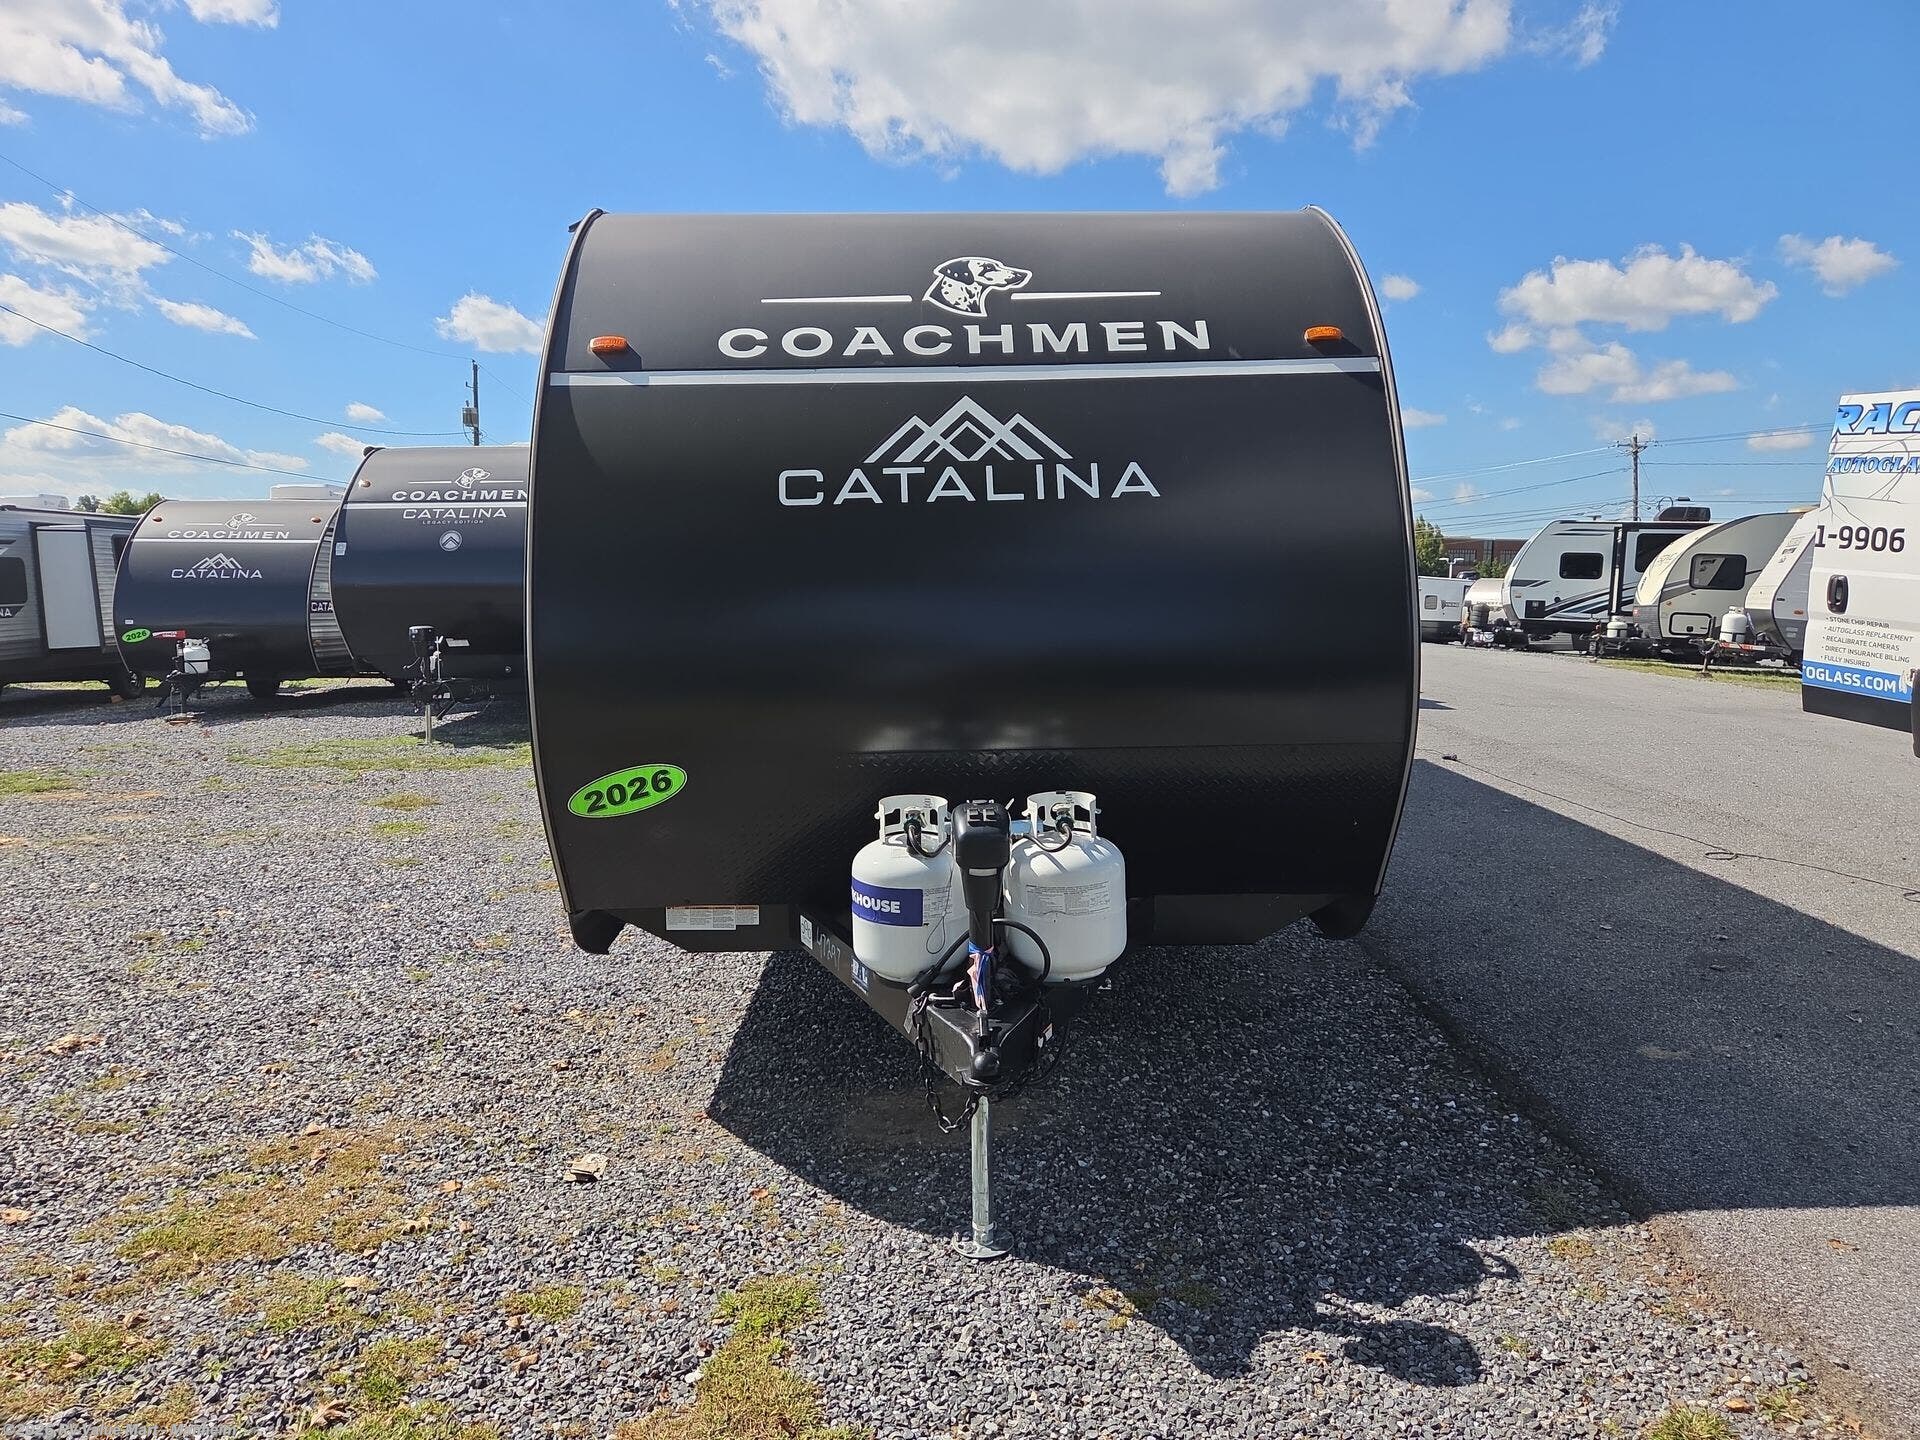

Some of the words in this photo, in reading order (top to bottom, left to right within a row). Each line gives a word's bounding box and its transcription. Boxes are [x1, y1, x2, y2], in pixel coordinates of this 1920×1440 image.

[718, 320, 1210, 358] COACHMEN
[1831, 401, 1920, 440] RAC
[1826, 455, 1920, 474] AUTOGLA
[778, 461, 1160, 506] CATALINA
[391, 490, 528, 501] COACHMEN
[403, 508, 507, 519] CATALINA
[167, 530, 290, 539] COACHMEN
[1815, 525, 1905, 553] 1-9906
[171, 568, 263, 579] CATALINA
[311, 602, 333, 611] CATA
[1829, 616, 1850, 624] STONE
[1851, 618, 1865, 626] CHIP
[1866, 620, 1890, 629] REPAIR
[126, 630, 147, 641] 2026
[1828, 626, 1865, 636] AUTOGLASS
[1865, 631, 1914, 642] REPLACEMENT
[1826, 635, 1868, 647] RECALIBRATE
[1868, 641, 1900, 651] CAMERAS
[1824, 655, 1842, 663] FULLY
[1843, 657, 1871, 668] INSURED
[1825, 645, 1847, 654] DIRECT
[1848, 648, 1883, 660] INSURANCE
[1884, 653, 1910, 663] BILLING
[584, 769, 673, 813] 2026
